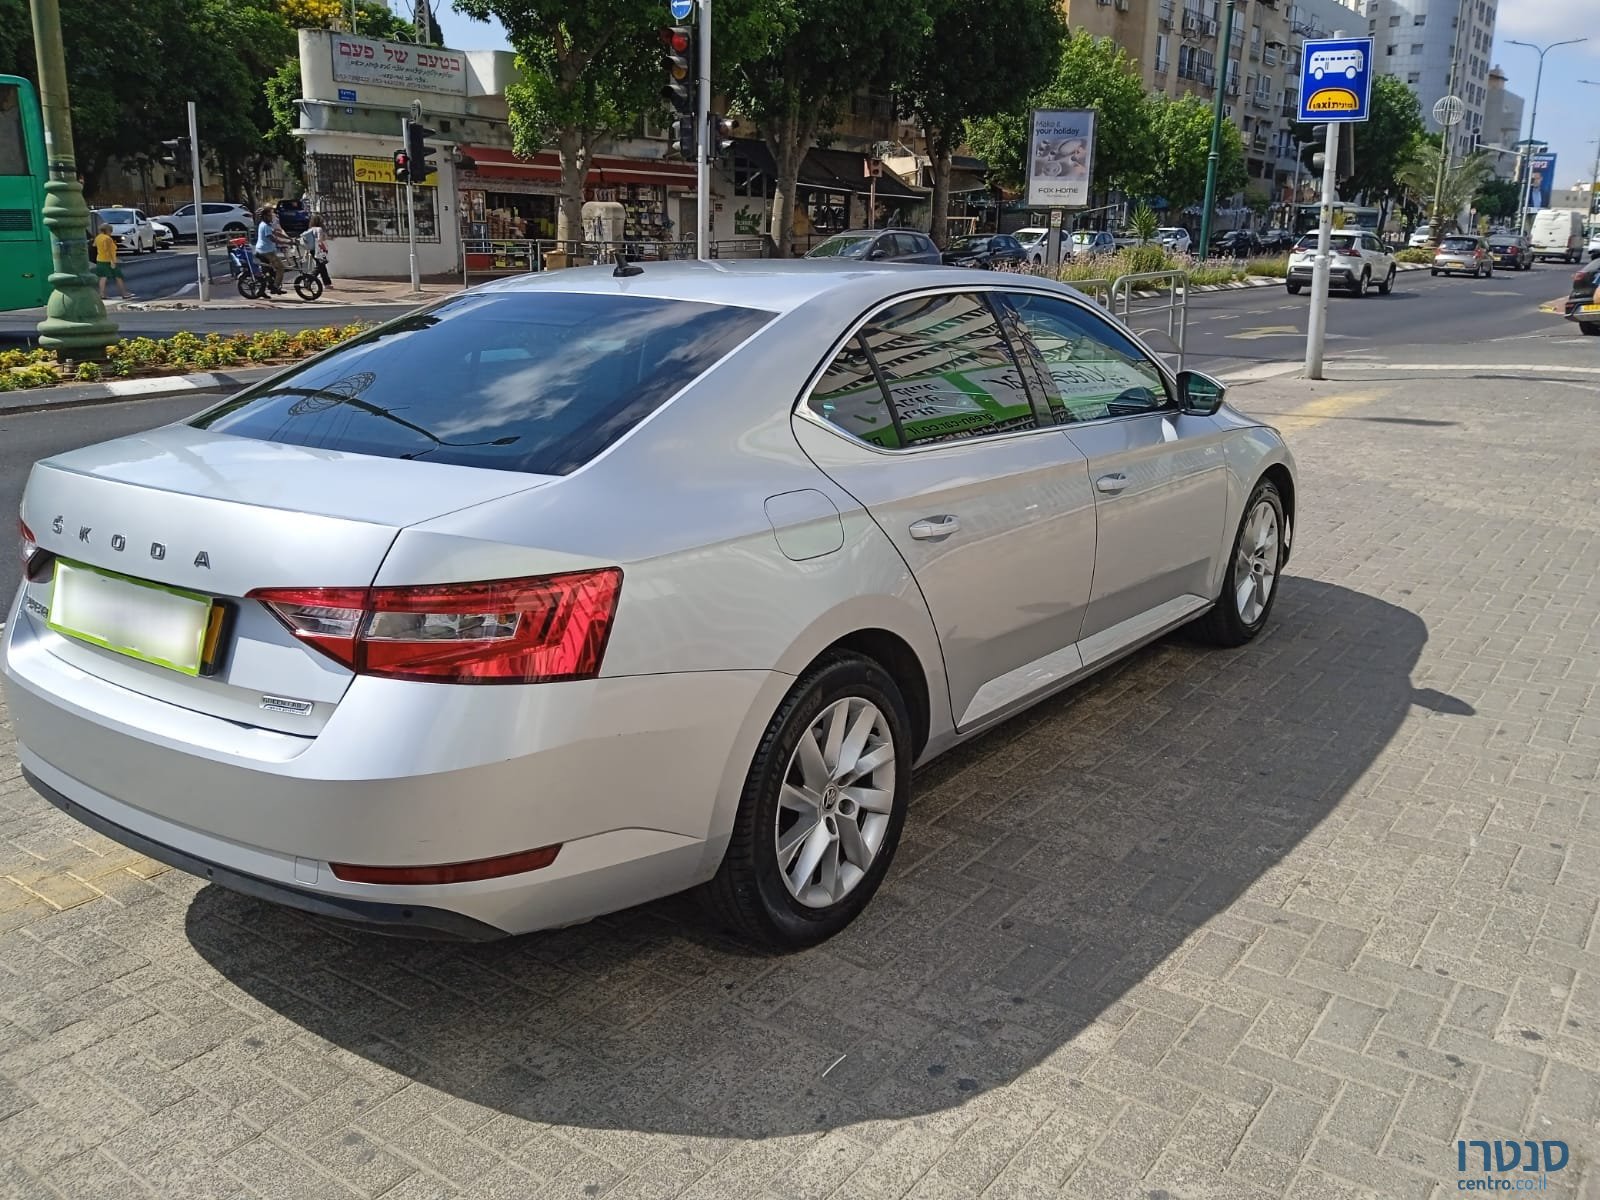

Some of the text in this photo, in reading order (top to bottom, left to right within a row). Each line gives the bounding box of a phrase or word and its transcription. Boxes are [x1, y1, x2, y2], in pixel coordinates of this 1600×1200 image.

[339, 42, 375, 59] פעם
[382, 44, 409, 64] של
[416, 53, 460, 71] בטעם
[1036, 120, 1055, 128] Make
[1054, 128, 1080, 137] holiday
